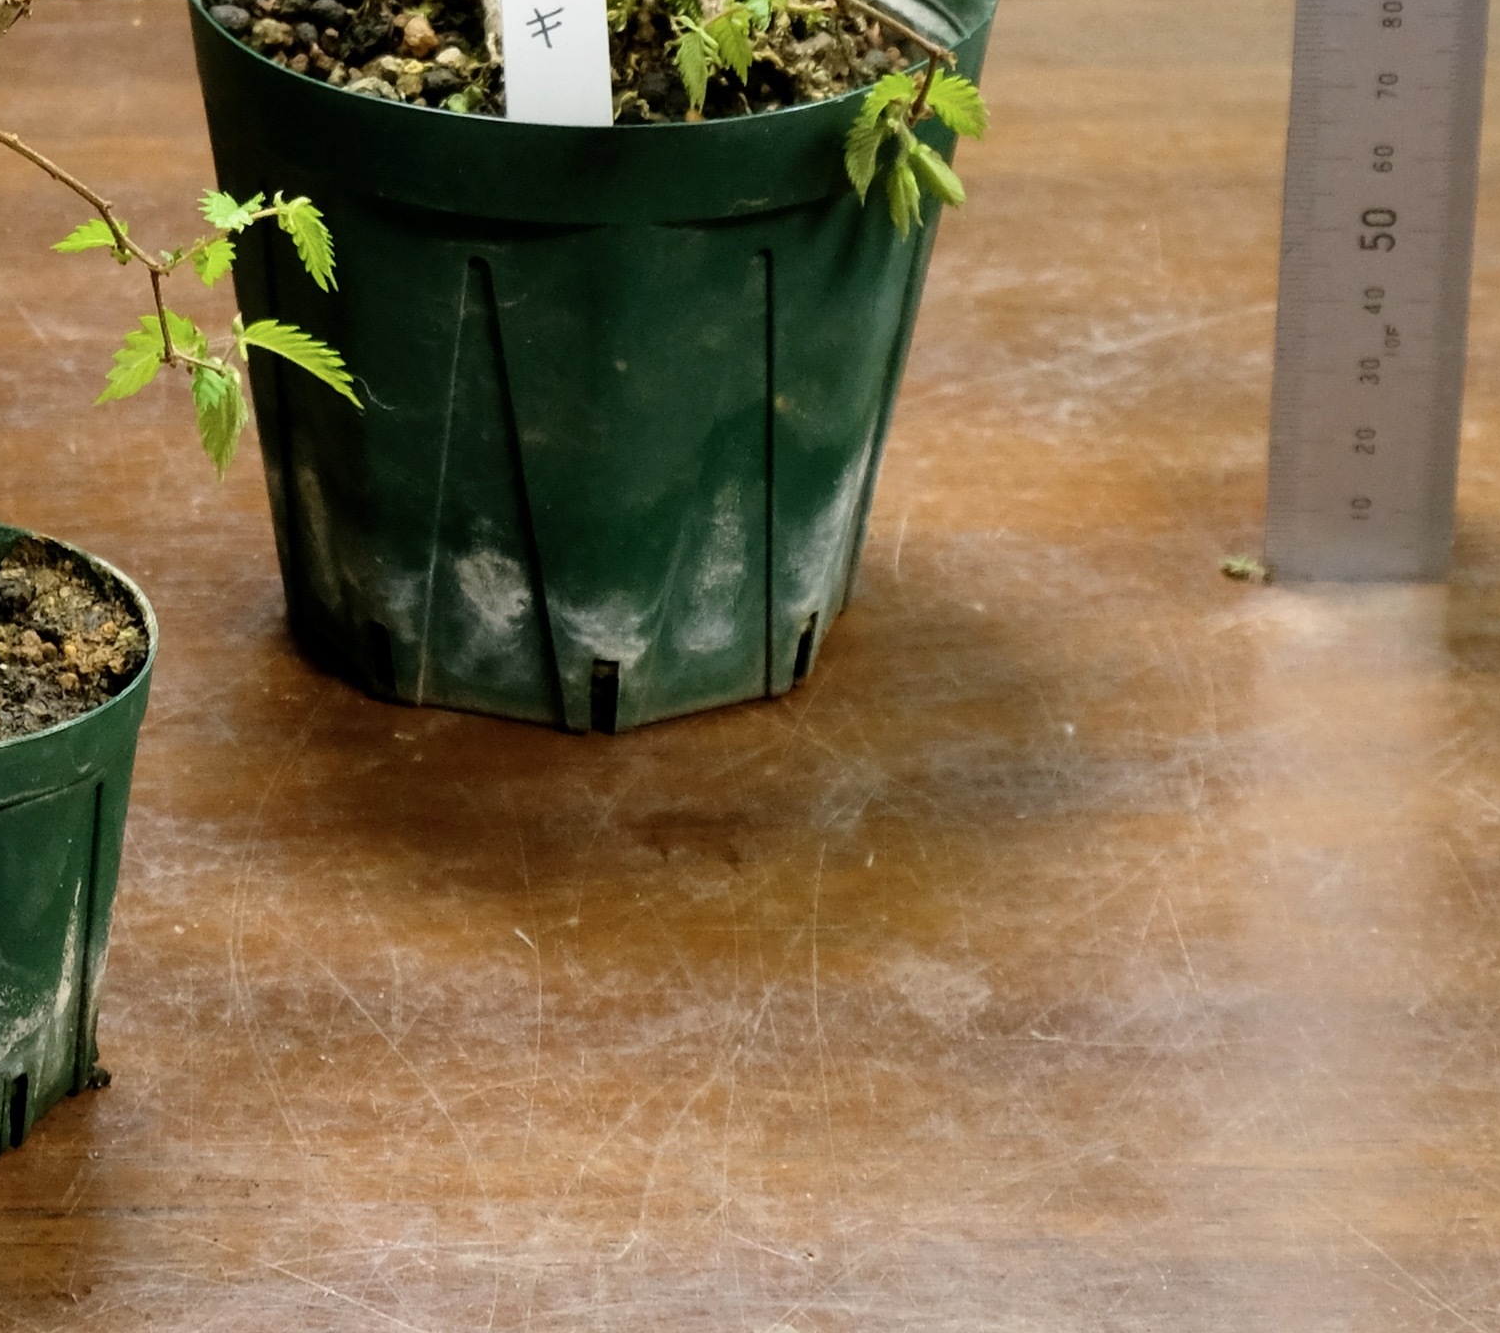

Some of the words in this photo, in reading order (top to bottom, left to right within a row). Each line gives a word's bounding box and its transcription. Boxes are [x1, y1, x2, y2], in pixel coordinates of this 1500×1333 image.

[1382, 0, 1403, 28] 80
[1376, 73, 1399, 99] 70
[1372, 145, 1394, 173] 60
[1359, 208, 1398, 253] 50
[1363, 287, 1386, 315] 40
[1359, 357, 1381, 384] 30
[1354, 427, 1377, 455] 20
[1351, 497, 1372, 520] 10
